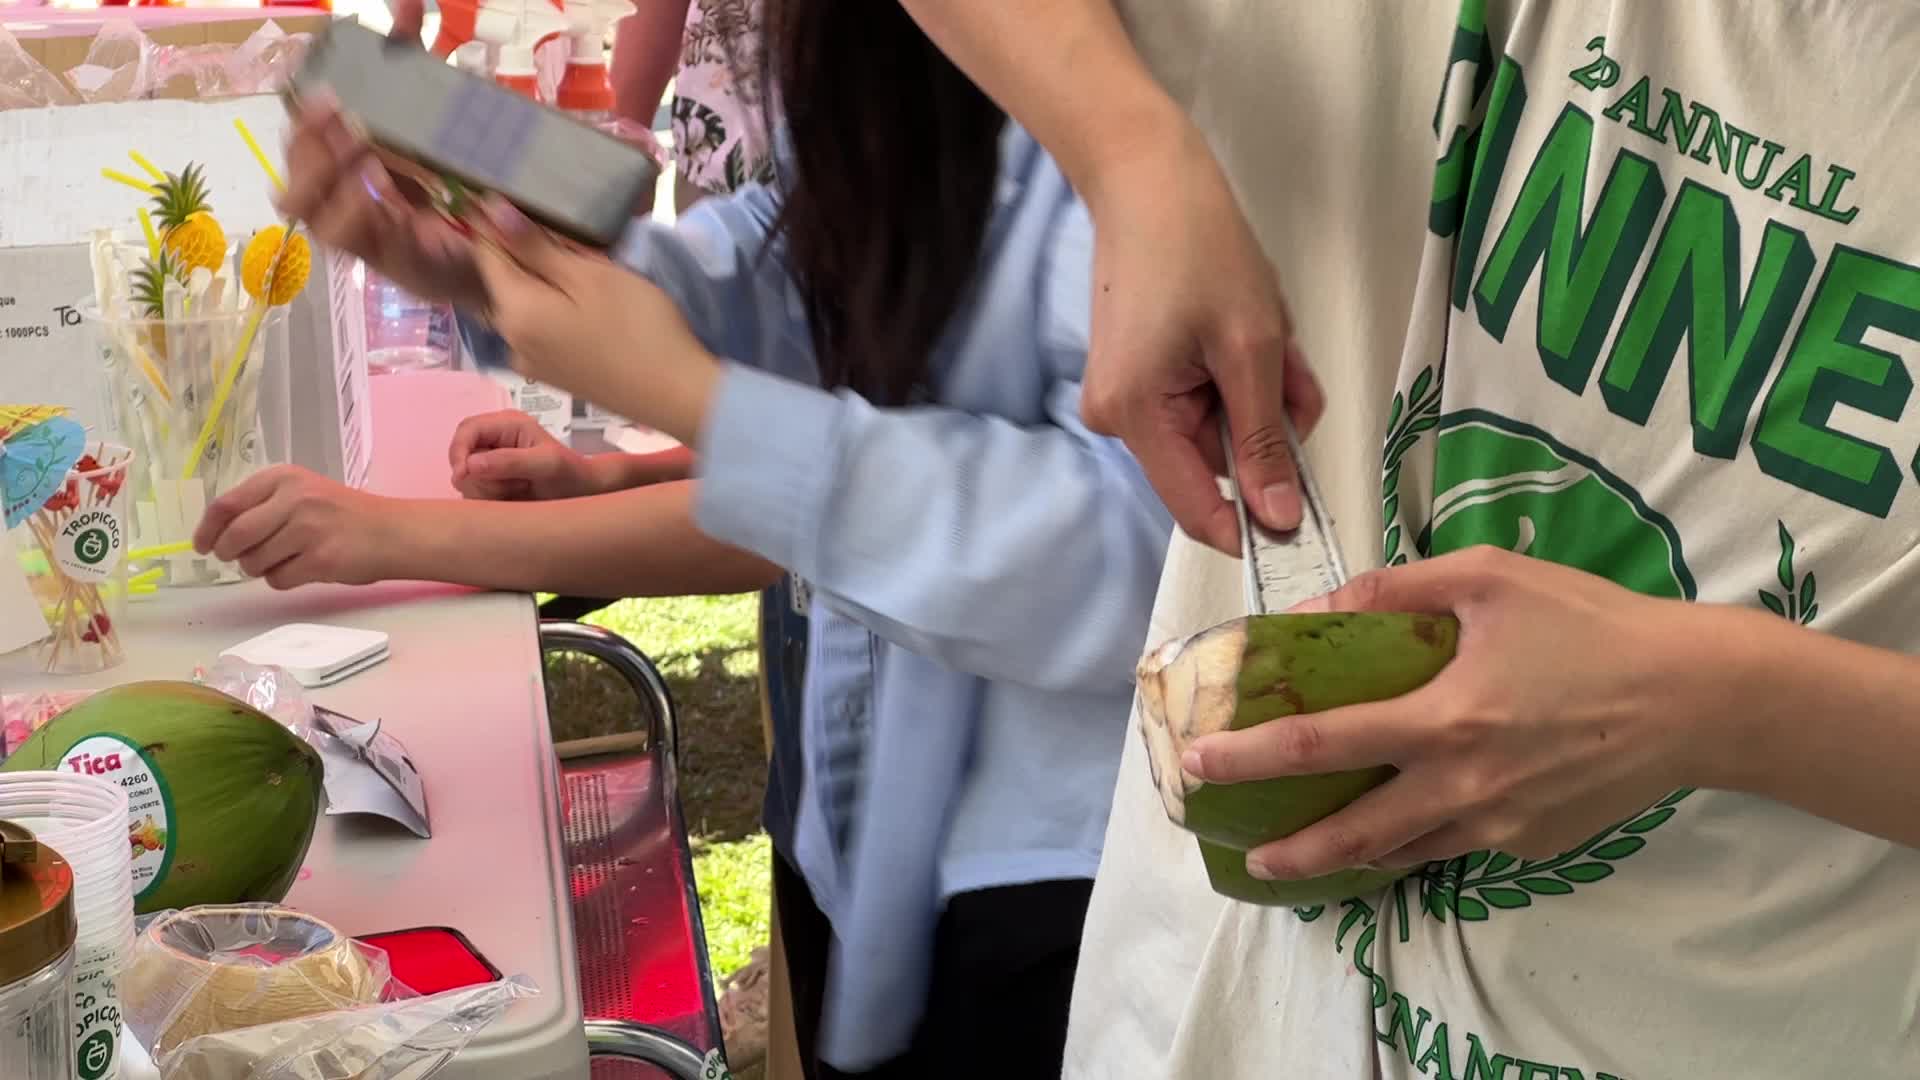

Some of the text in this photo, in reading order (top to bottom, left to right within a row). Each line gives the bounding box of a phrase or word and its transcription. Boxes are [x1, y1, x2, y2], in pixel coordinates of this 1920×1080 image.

[1602, 75, 1861, 225] ANNUAL
[62, 511, 120, 549] TROPICOCO
[68, 752, 122, 776] Tica
[121, 773, 148, 787] 4260
